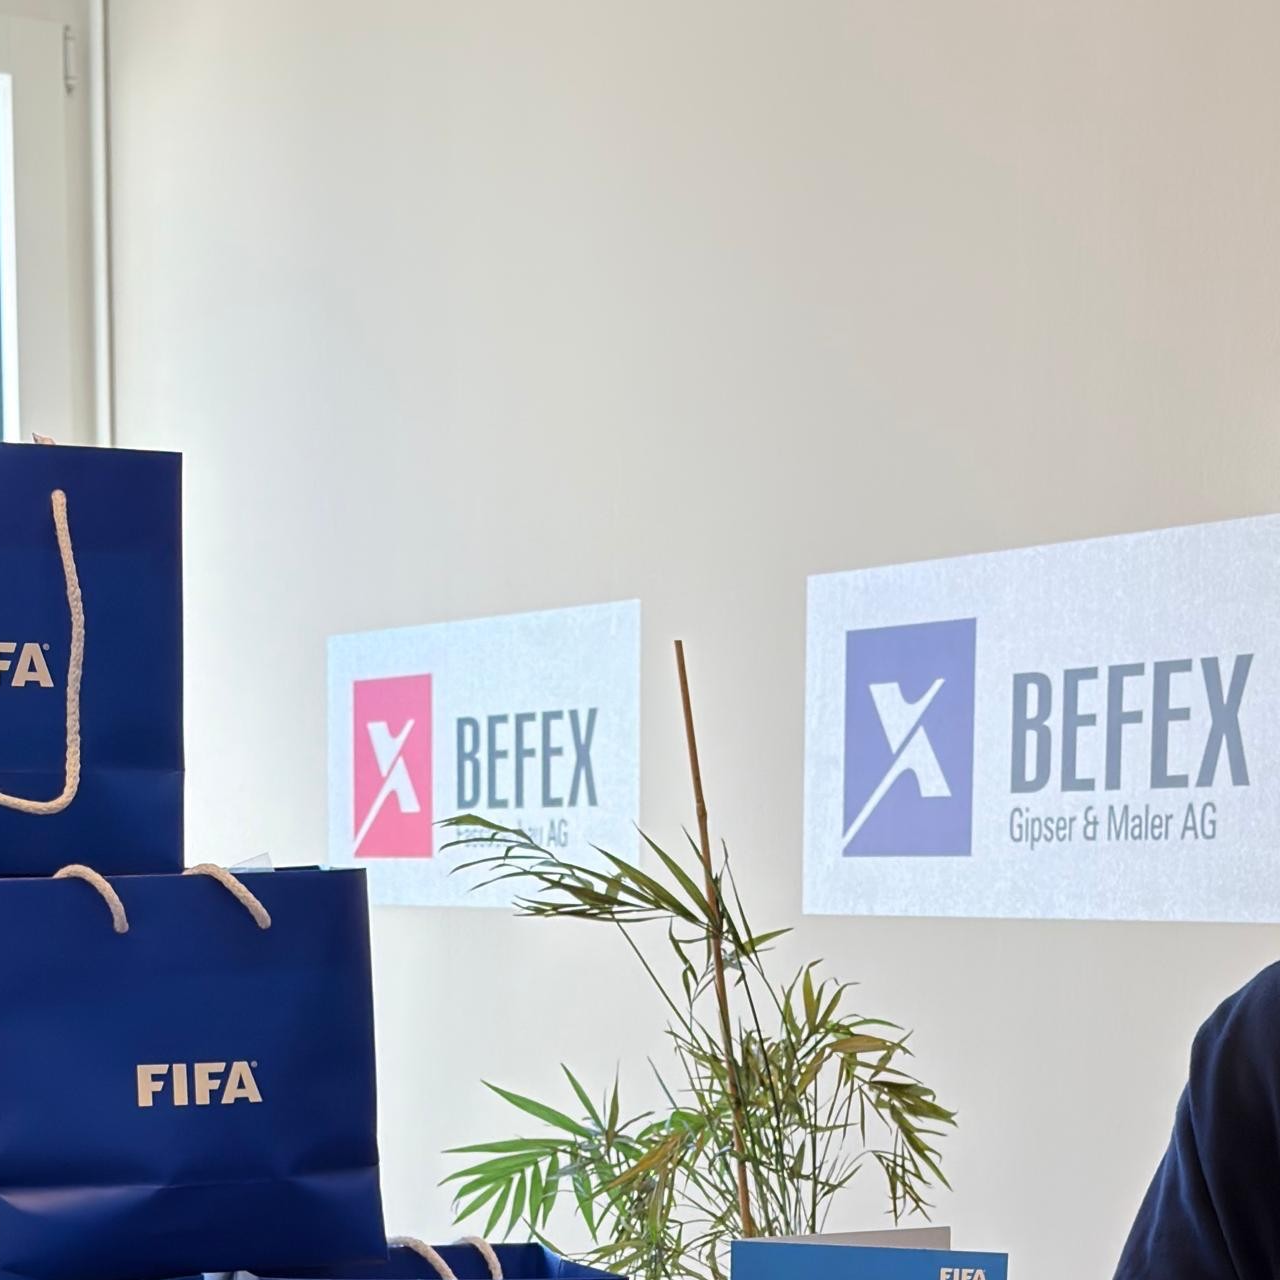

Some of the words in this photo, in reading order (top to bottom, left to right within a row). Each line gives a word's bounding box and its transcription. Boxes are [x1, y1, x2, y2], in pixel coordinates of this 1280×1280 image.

[1010, 653, 1255, 794] BEFEX
[456, 707, 599, 810] BEFEX
[547, 817, 569, 848] AG
[1009, 806, 1077, 850] Gipser
[1083, 805, 1099, 841] &
[1107, 803, 1173, 841] Maler
[1180, 801, 1217, 841] AG
[137, 1061, 263, 1107] FIFA
